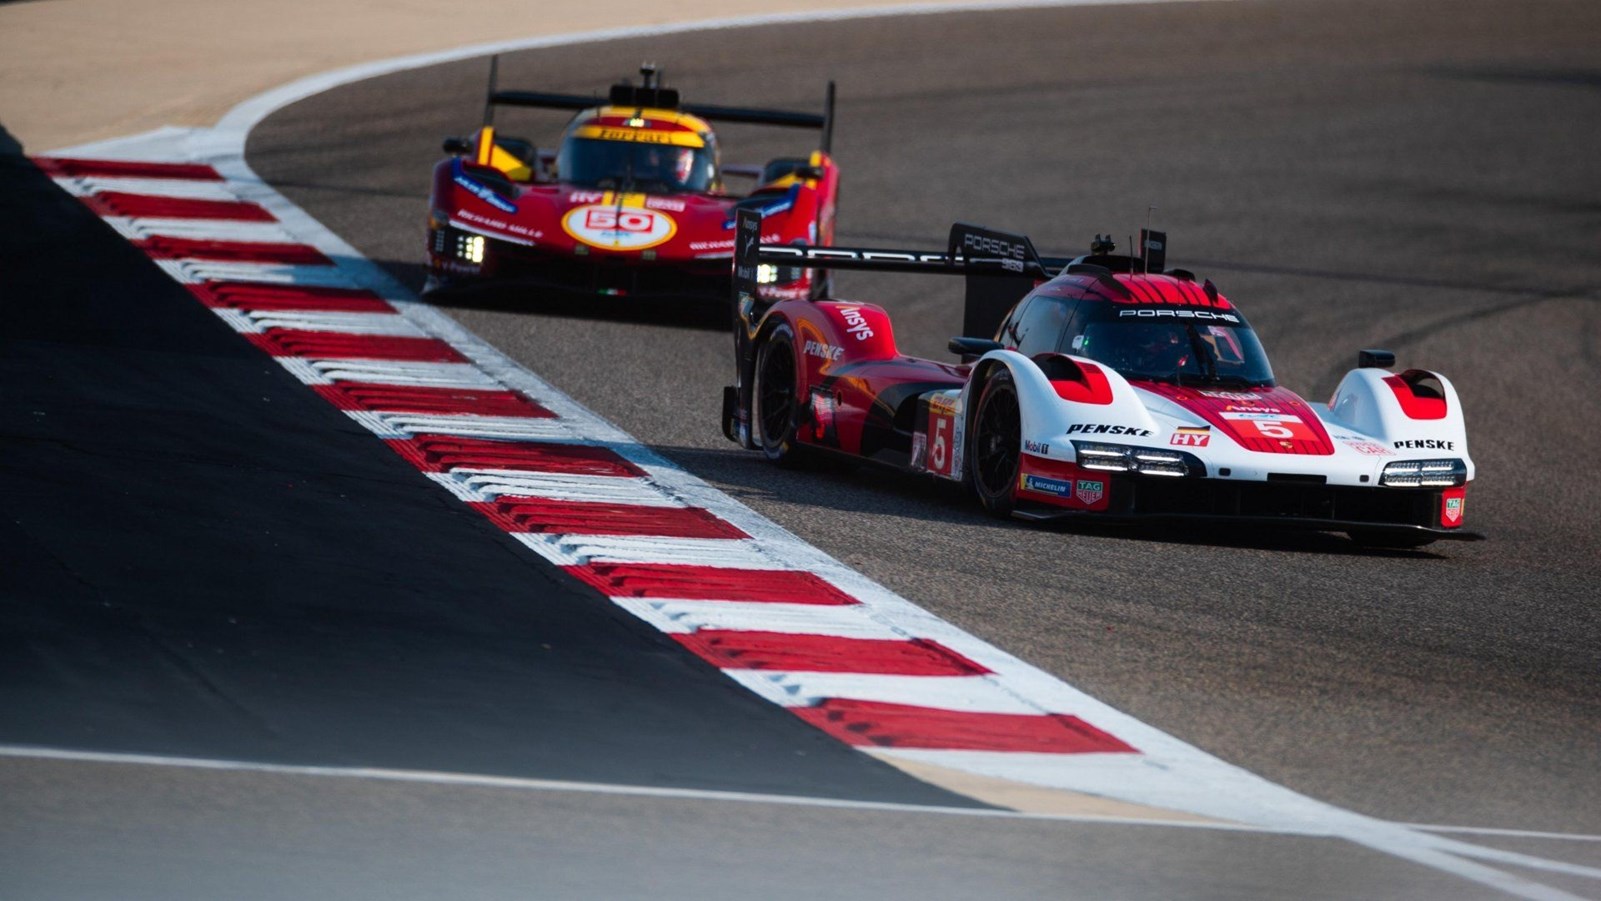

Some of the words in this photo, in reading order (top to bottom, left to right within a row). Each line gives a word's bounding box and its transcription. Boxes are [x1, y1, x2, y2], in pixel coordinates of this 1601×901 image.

[601, 129, 673, 144] Ferrari
[588, 211, 653, 232] 50
[964, 233, 1025, 261] PORSCHE
[836, 305, 874, 341] Ansys
[1119, 309, 1240, 323] PORSCHE
[803, 340, 845, 361] PENSKE
[1066, 424, 1155, 437] PENSKE
[1252, 420, 1295, 439] 5
[932, 418, 947, 470] 5
[1025, 440, 1041, 453] Mobil
[1172, 433, 1208, 446] HY
[1394, 439, 1455, 451] PENSKE
[1034, 480, 1067, 493] MICHELIN
[1079, 482, 1101, 491] TAG
